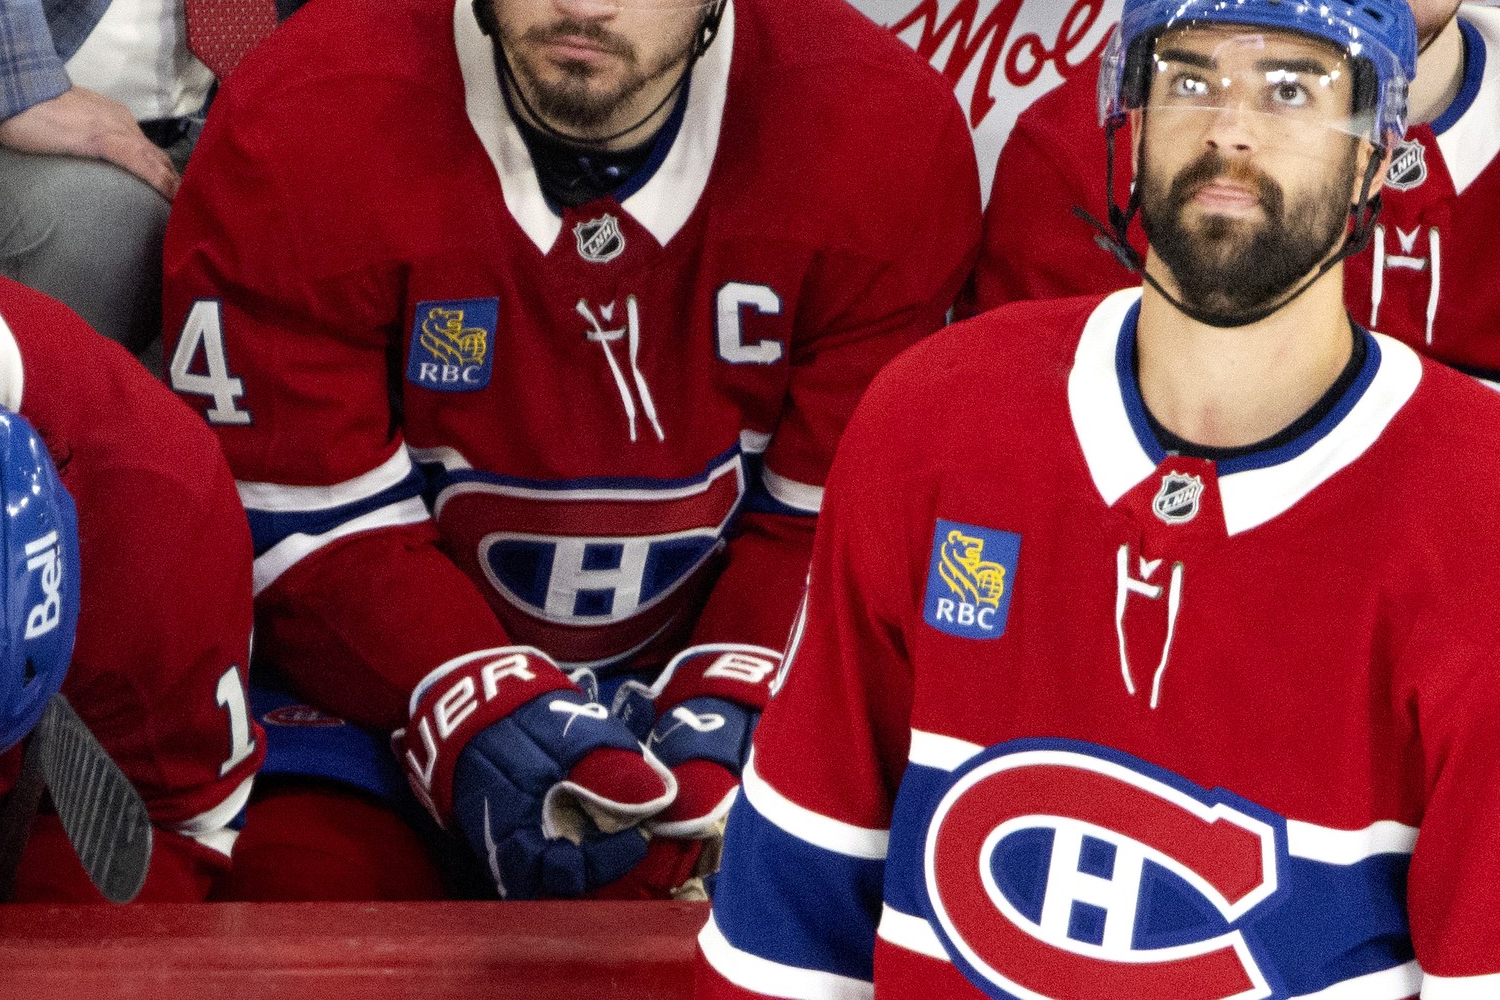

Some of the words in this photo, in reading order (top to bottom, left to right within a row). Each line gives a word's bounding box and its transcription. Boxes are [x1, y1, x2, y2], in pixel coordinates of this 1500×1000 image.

[1389, 147, 1418, 181] LNH
[587, 221, 614, 256] LNH
[714, 281, 784, 366] C
[169, 299, 252, 424] 4
[418, 361, 483, 384] RBC
[1161, 486, 1198, 512] LNH
[23, 530, 62, 640] Bell
[935, 597, 997, 631] RBC
[703, 651, 777, 698] B
